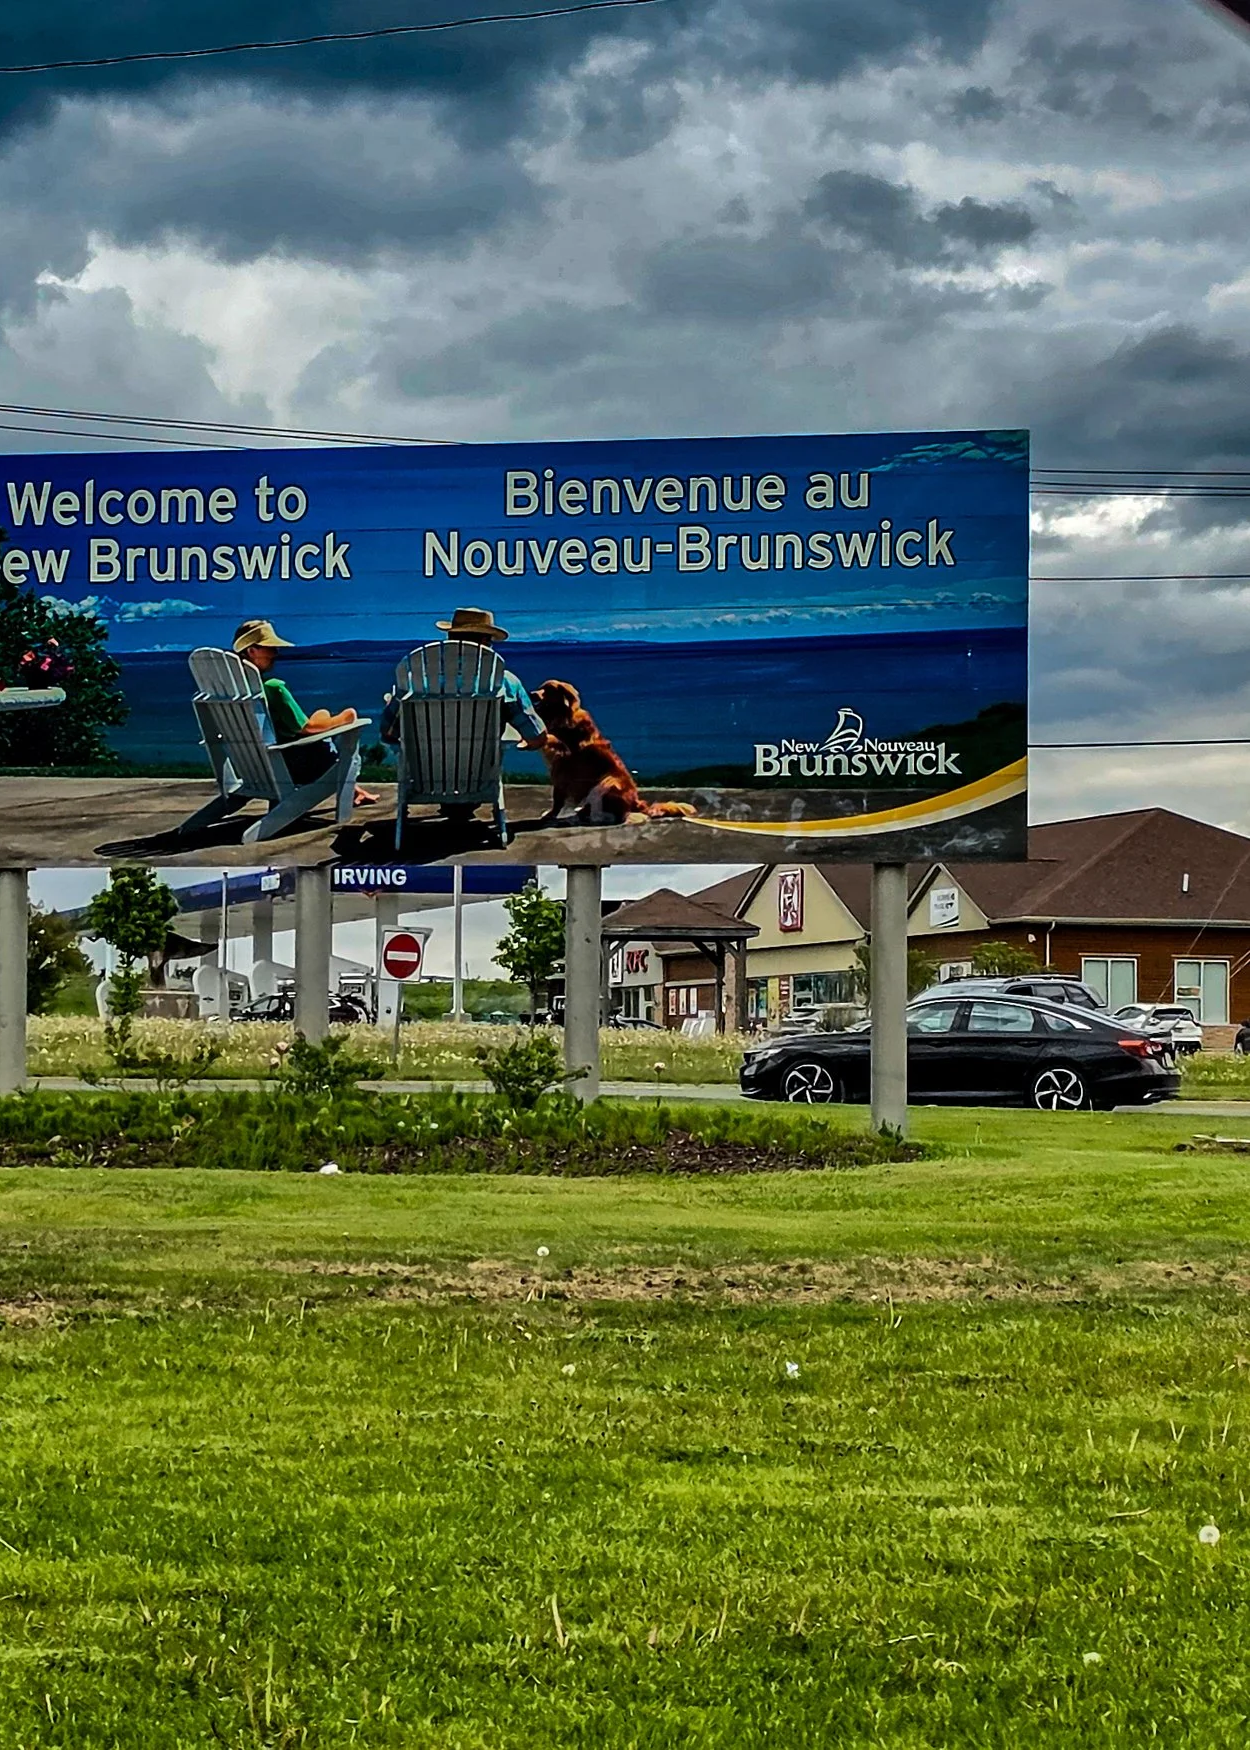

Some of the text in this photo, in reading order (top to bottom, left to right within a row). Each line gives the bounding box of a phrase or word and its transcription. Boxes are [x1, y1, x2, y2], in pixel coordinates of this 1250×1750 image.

[6, 475, 307, 526] Welcome to
[505, 468, 869, 516] Bienvenue au
[89, 532, 351, 583] Brunswick
[424, 519, 955, 576] Nouveau-Brunswick
[753, 742, 963, 777] Brunswick
[781, 737, 936, 753] New Nouveau
[333, 868, 407, 886] IRVING
